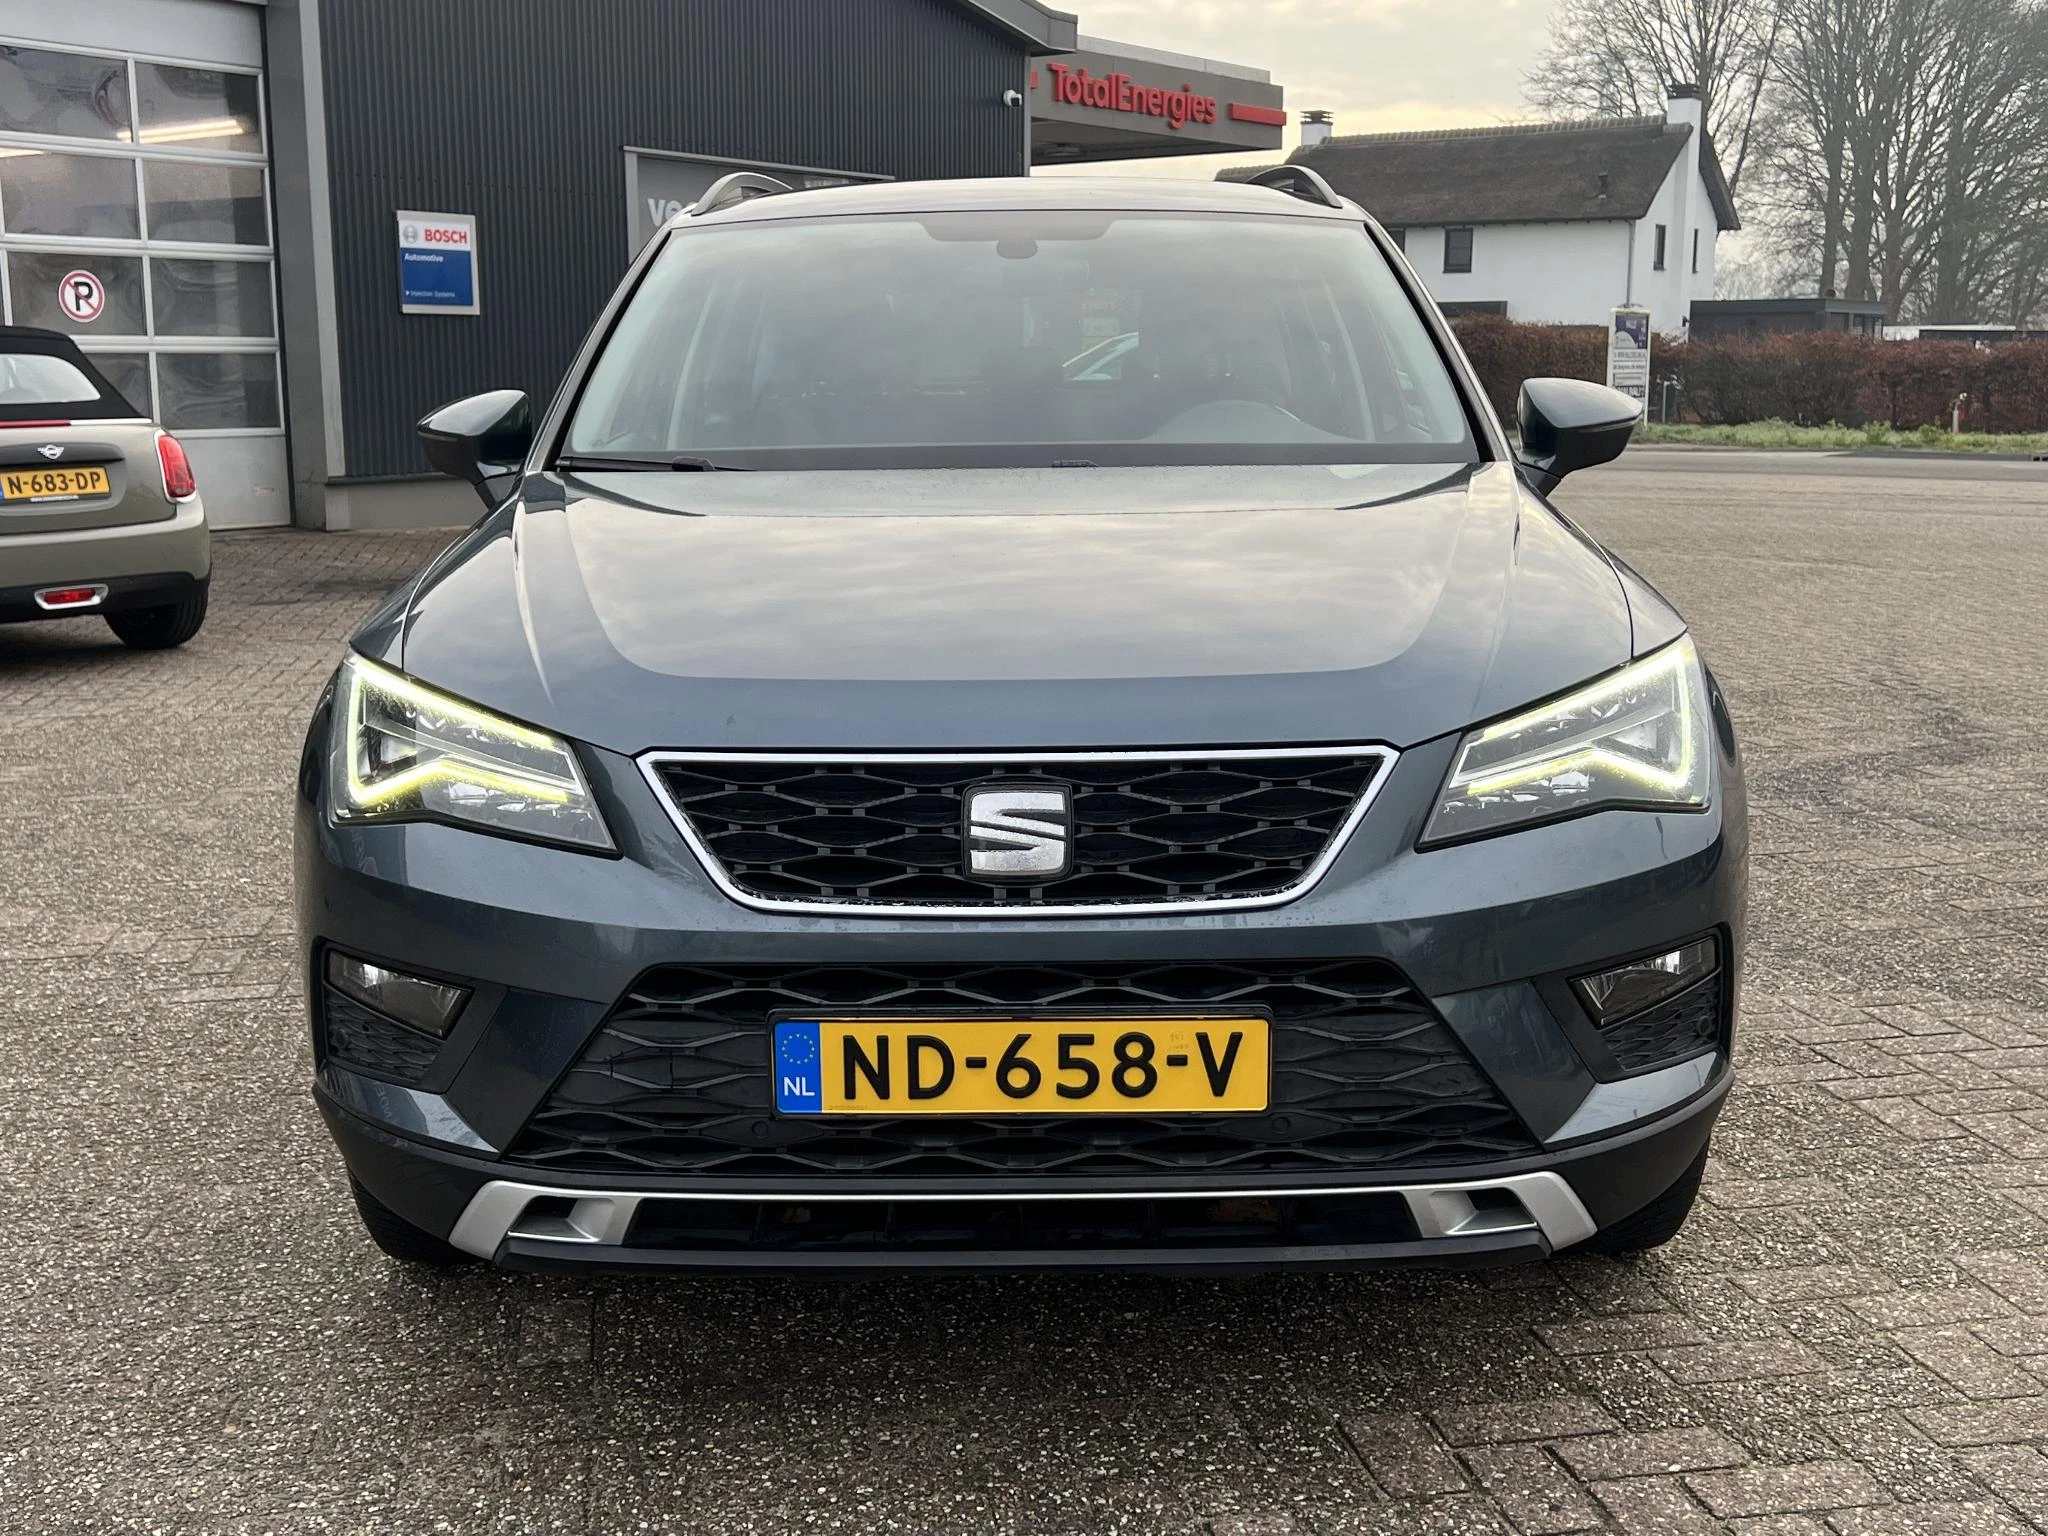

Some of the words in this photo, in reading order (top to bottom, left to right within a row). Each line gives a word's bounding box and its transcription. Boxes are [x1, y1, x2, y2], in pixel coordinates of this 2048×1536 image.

[1048, 63, 1217, 129] TotalEnergies
[424, 229, 468, 244] BOSCH
[404, 253, 444, 263] Automotive
[7, 471, 101, 495] N-683-DP
[843, 1031, 1244, 1100] ND-658-V
[783, 1076, 815, 1097] NL
